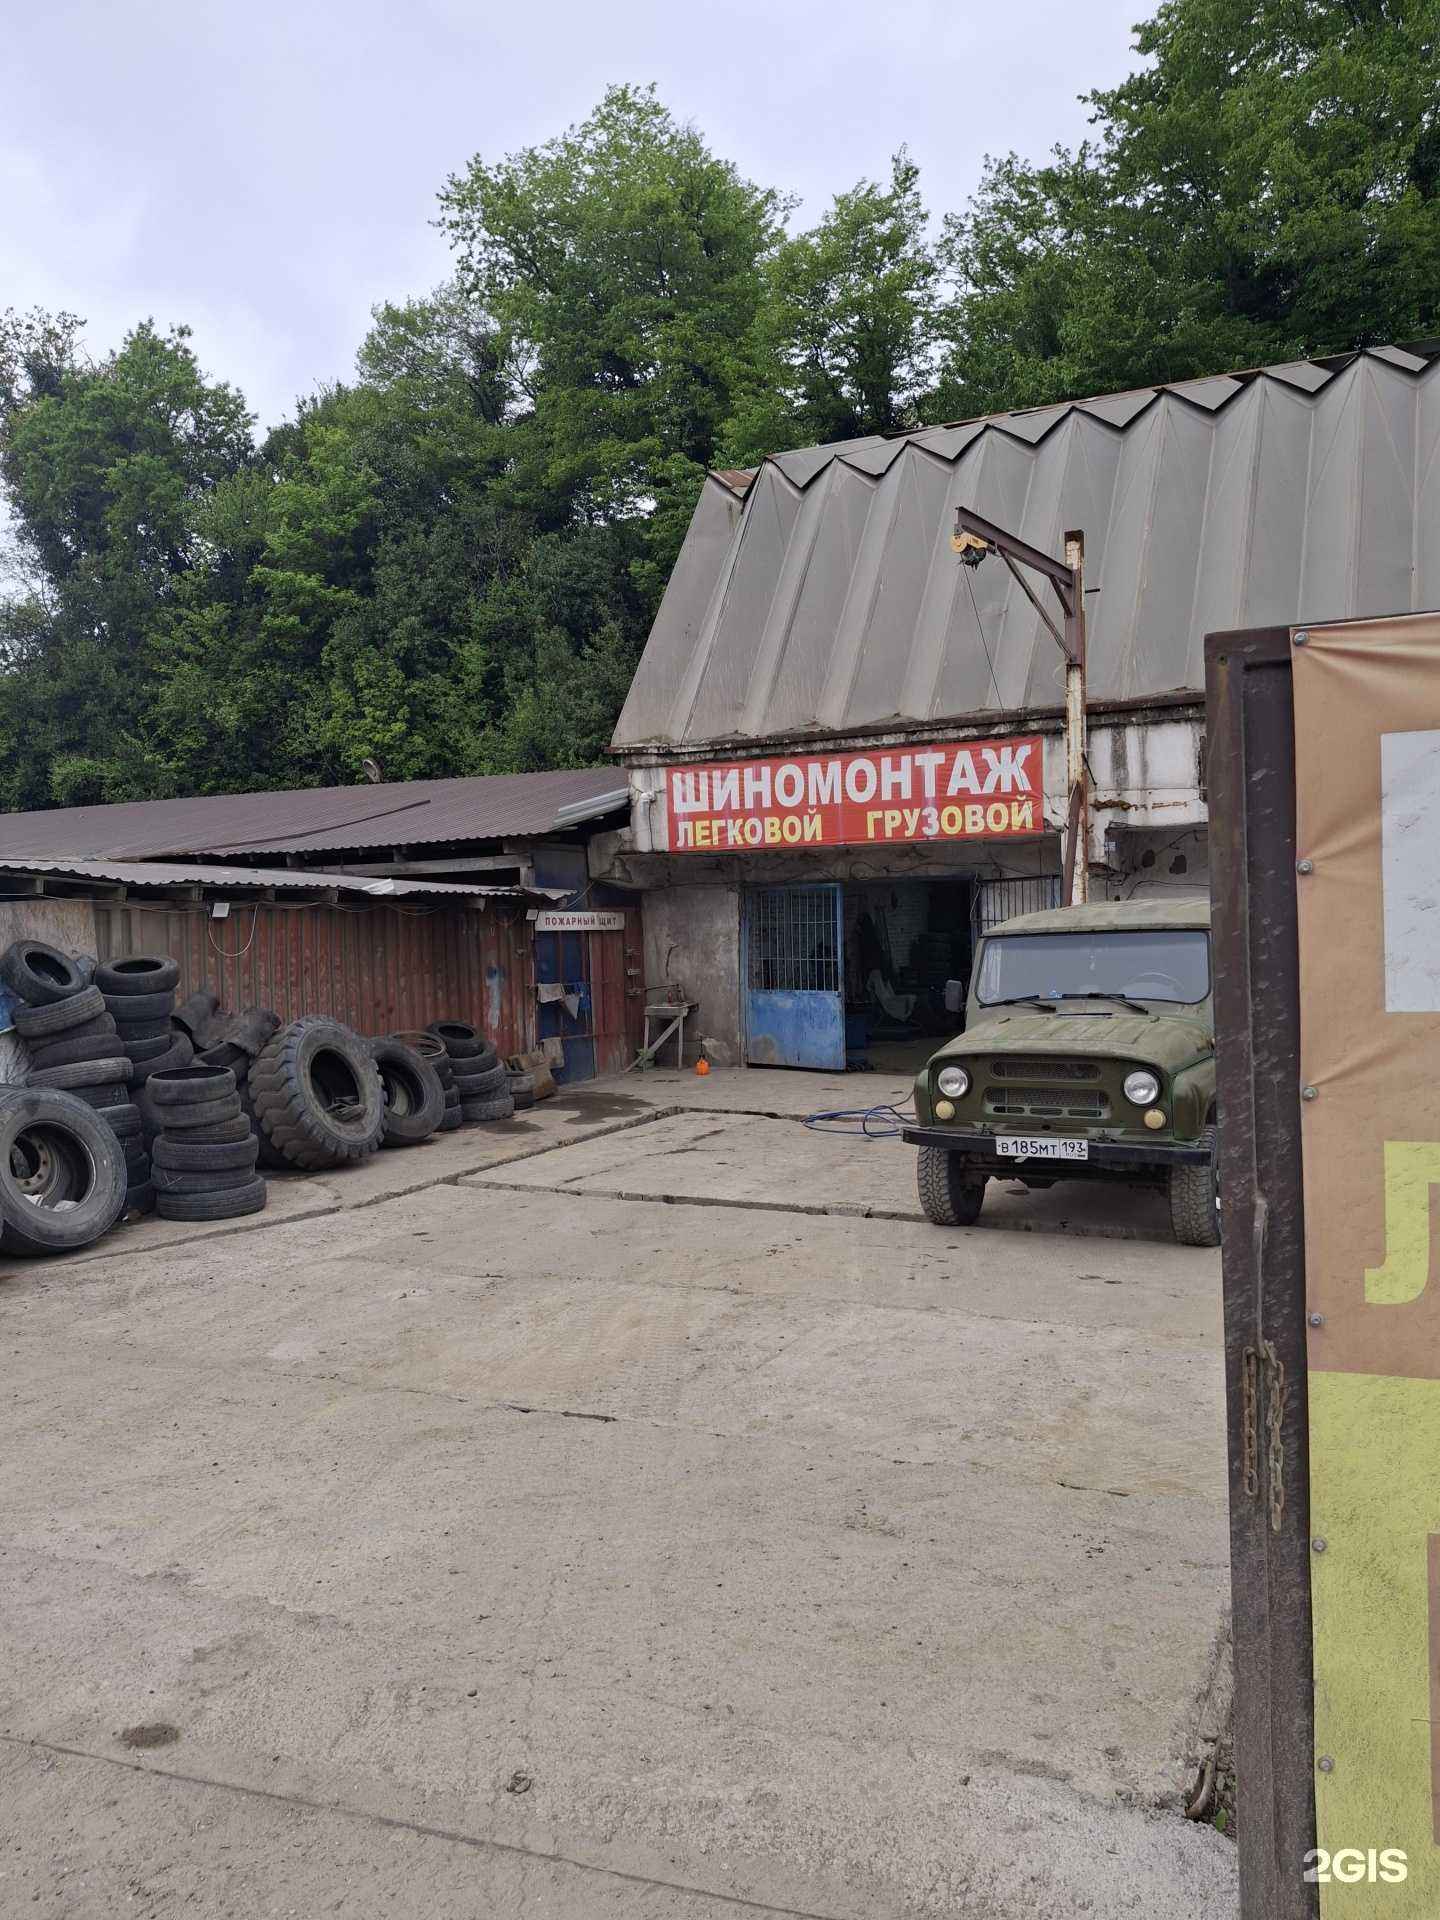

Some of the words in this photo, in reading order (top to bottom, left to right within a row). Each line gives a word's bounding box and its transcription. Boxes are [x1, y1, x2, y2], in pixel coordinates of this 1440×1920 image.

[673, 745, 1032, 812] ШИНОМОНТАЖ
[676, 809, 823, 848] ЛЕГКОВОЙ
[866, 795, 1033, 839] ГРУЗОВОЙ
[600, 916, 617, 926] ЩИТ
[1062, 1141, 1083, 1153] 193
